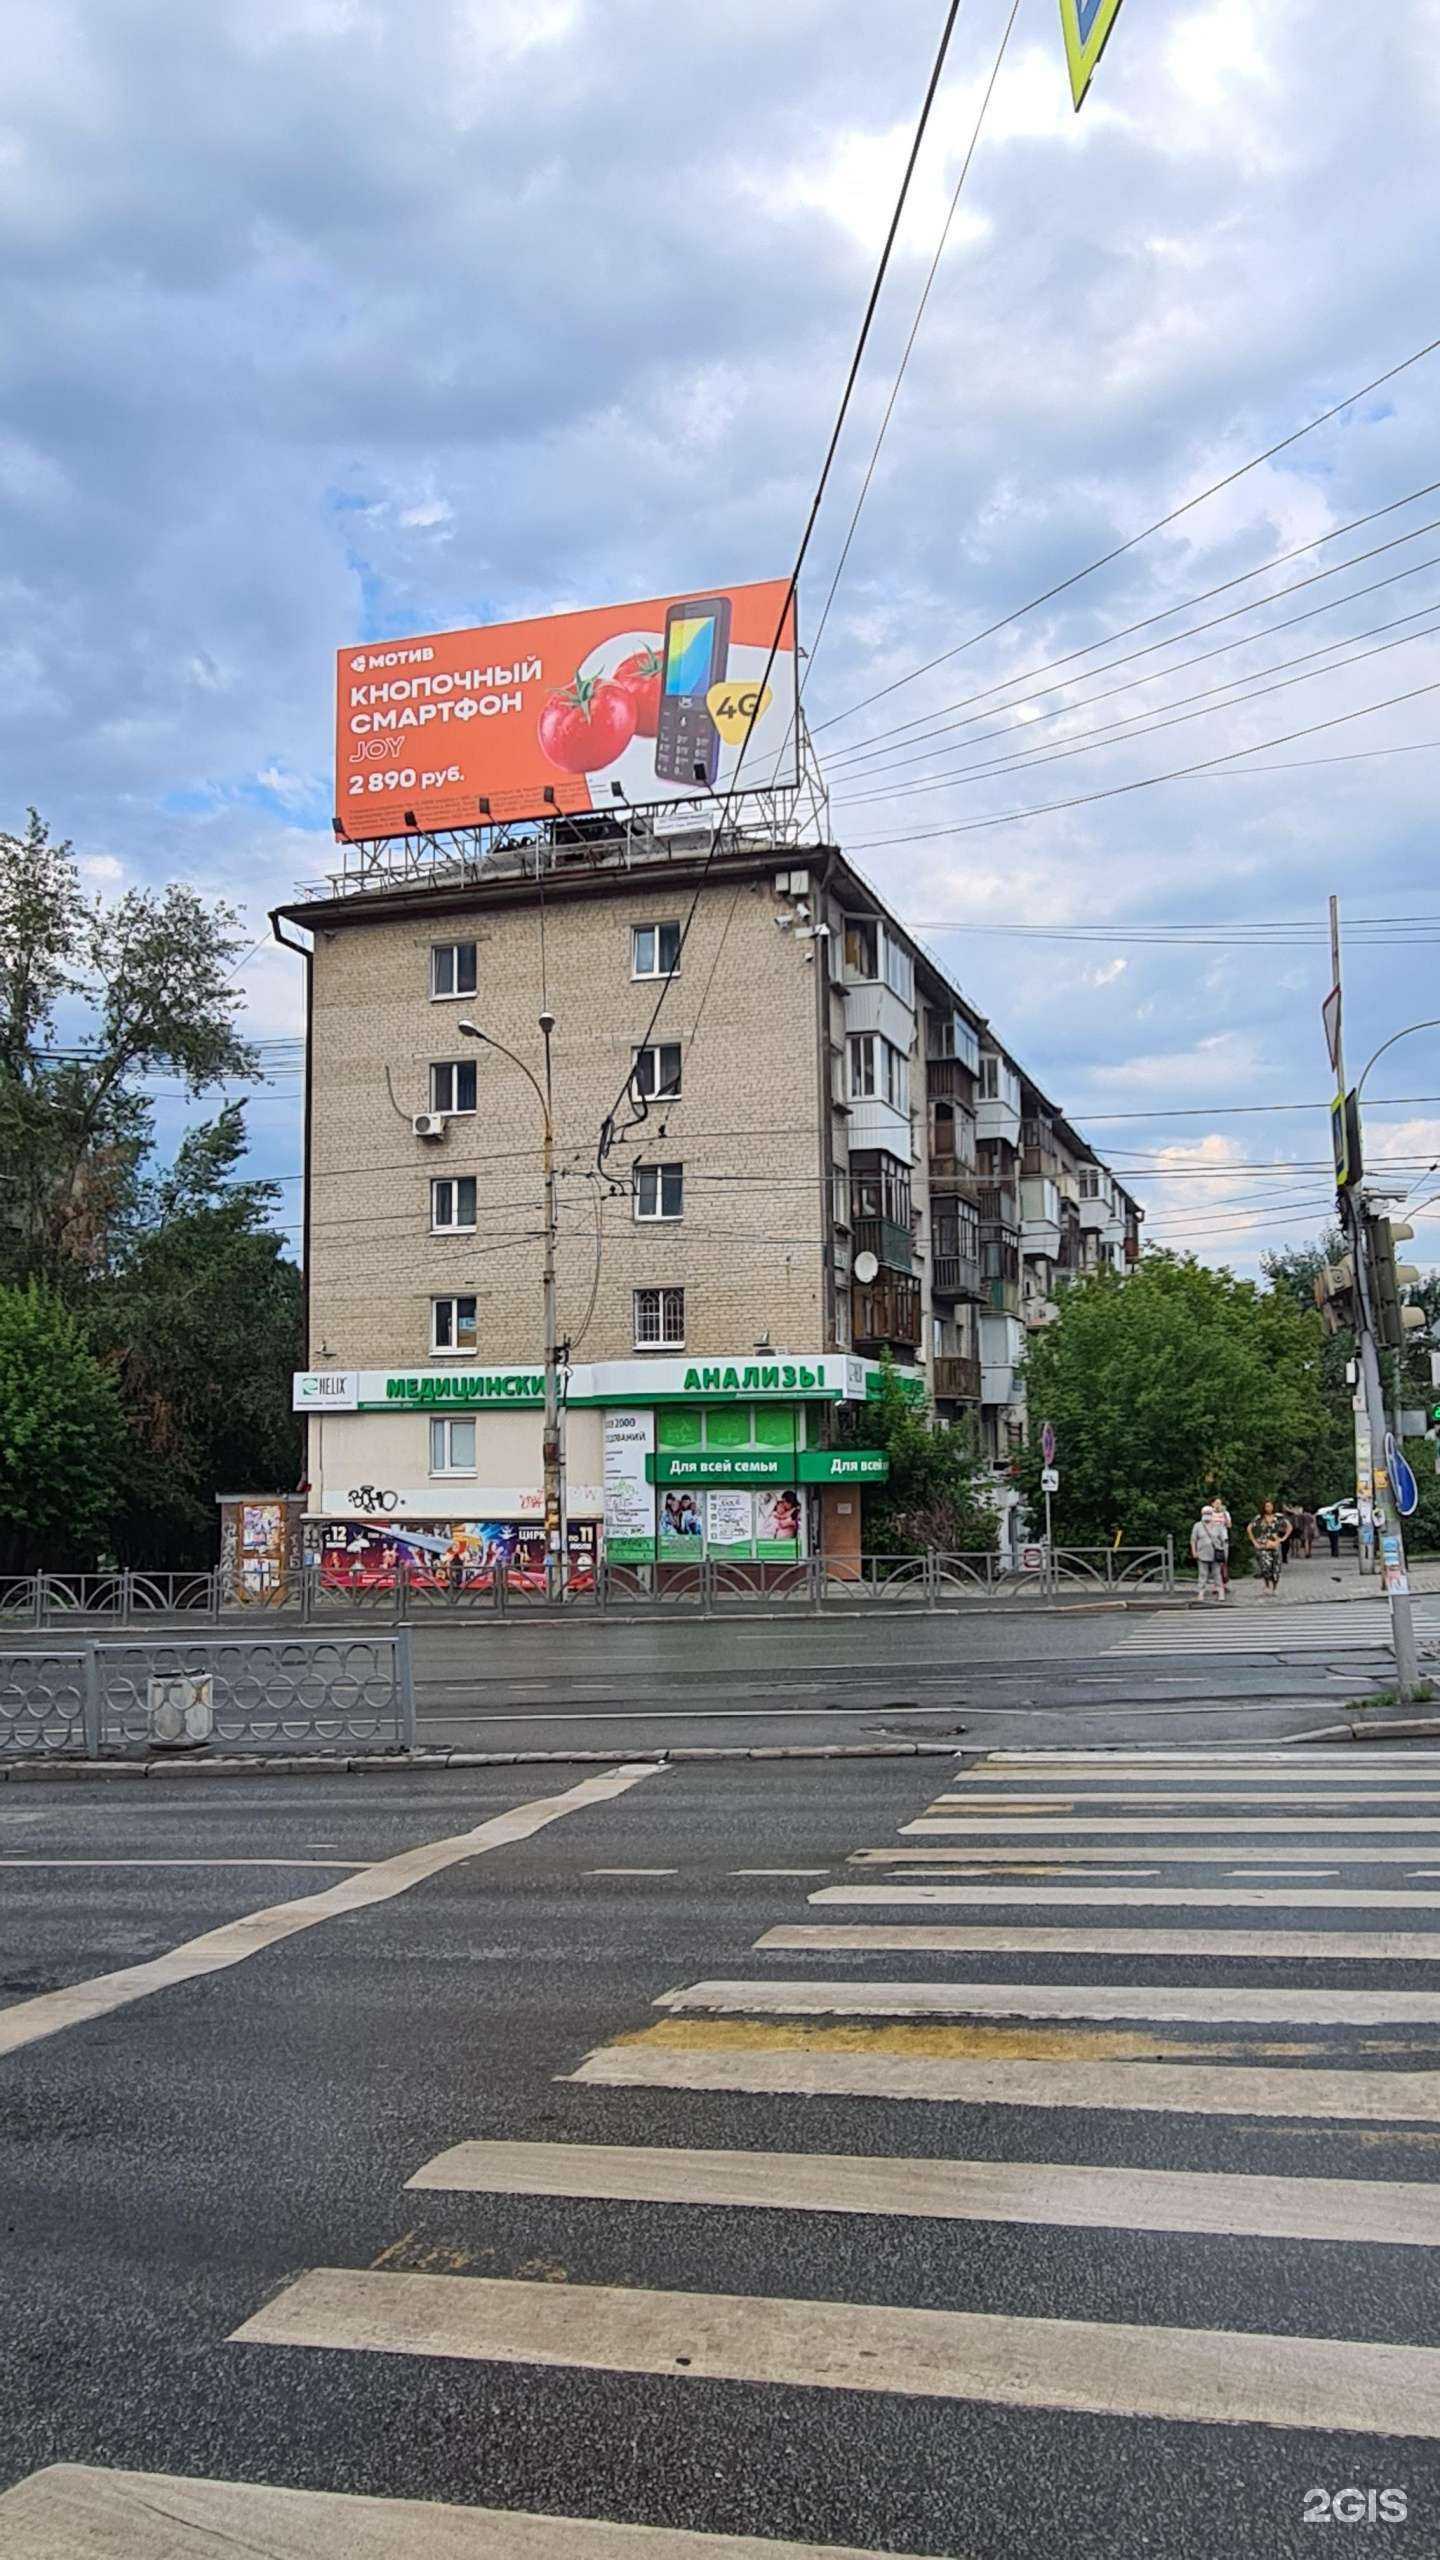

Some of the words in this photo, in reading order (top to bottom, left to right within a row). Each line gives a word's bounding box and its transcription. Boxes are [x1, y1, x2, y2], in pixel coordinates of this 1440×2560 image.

[369, 647, 435, 669] МОТИВ
[350, 655, 543, 707] КНОПОЧНЫЙ
[350, 691, 523, 734] СМАРТФОН
[716, 693, 759, 719] 4G
[349, 736, 406, 763] JOY
[421, 766, 465, 789] руб.
[319, 1377, 347, 1395] HELIX
[683, 1365, 824, 1390] АНАЛИЗЫ
[670, 1460, 697, 1475] Для
[700, 1459, 731, 1473] всей
[734, 1461, 778, 1473] семьи
[830, 1459, 858, 1474] Для
[331, 1526, 347, 1541] 12
[518, 1530, 547, 1541] ЦИРК
[579, 1526, 593, 1542] 11
